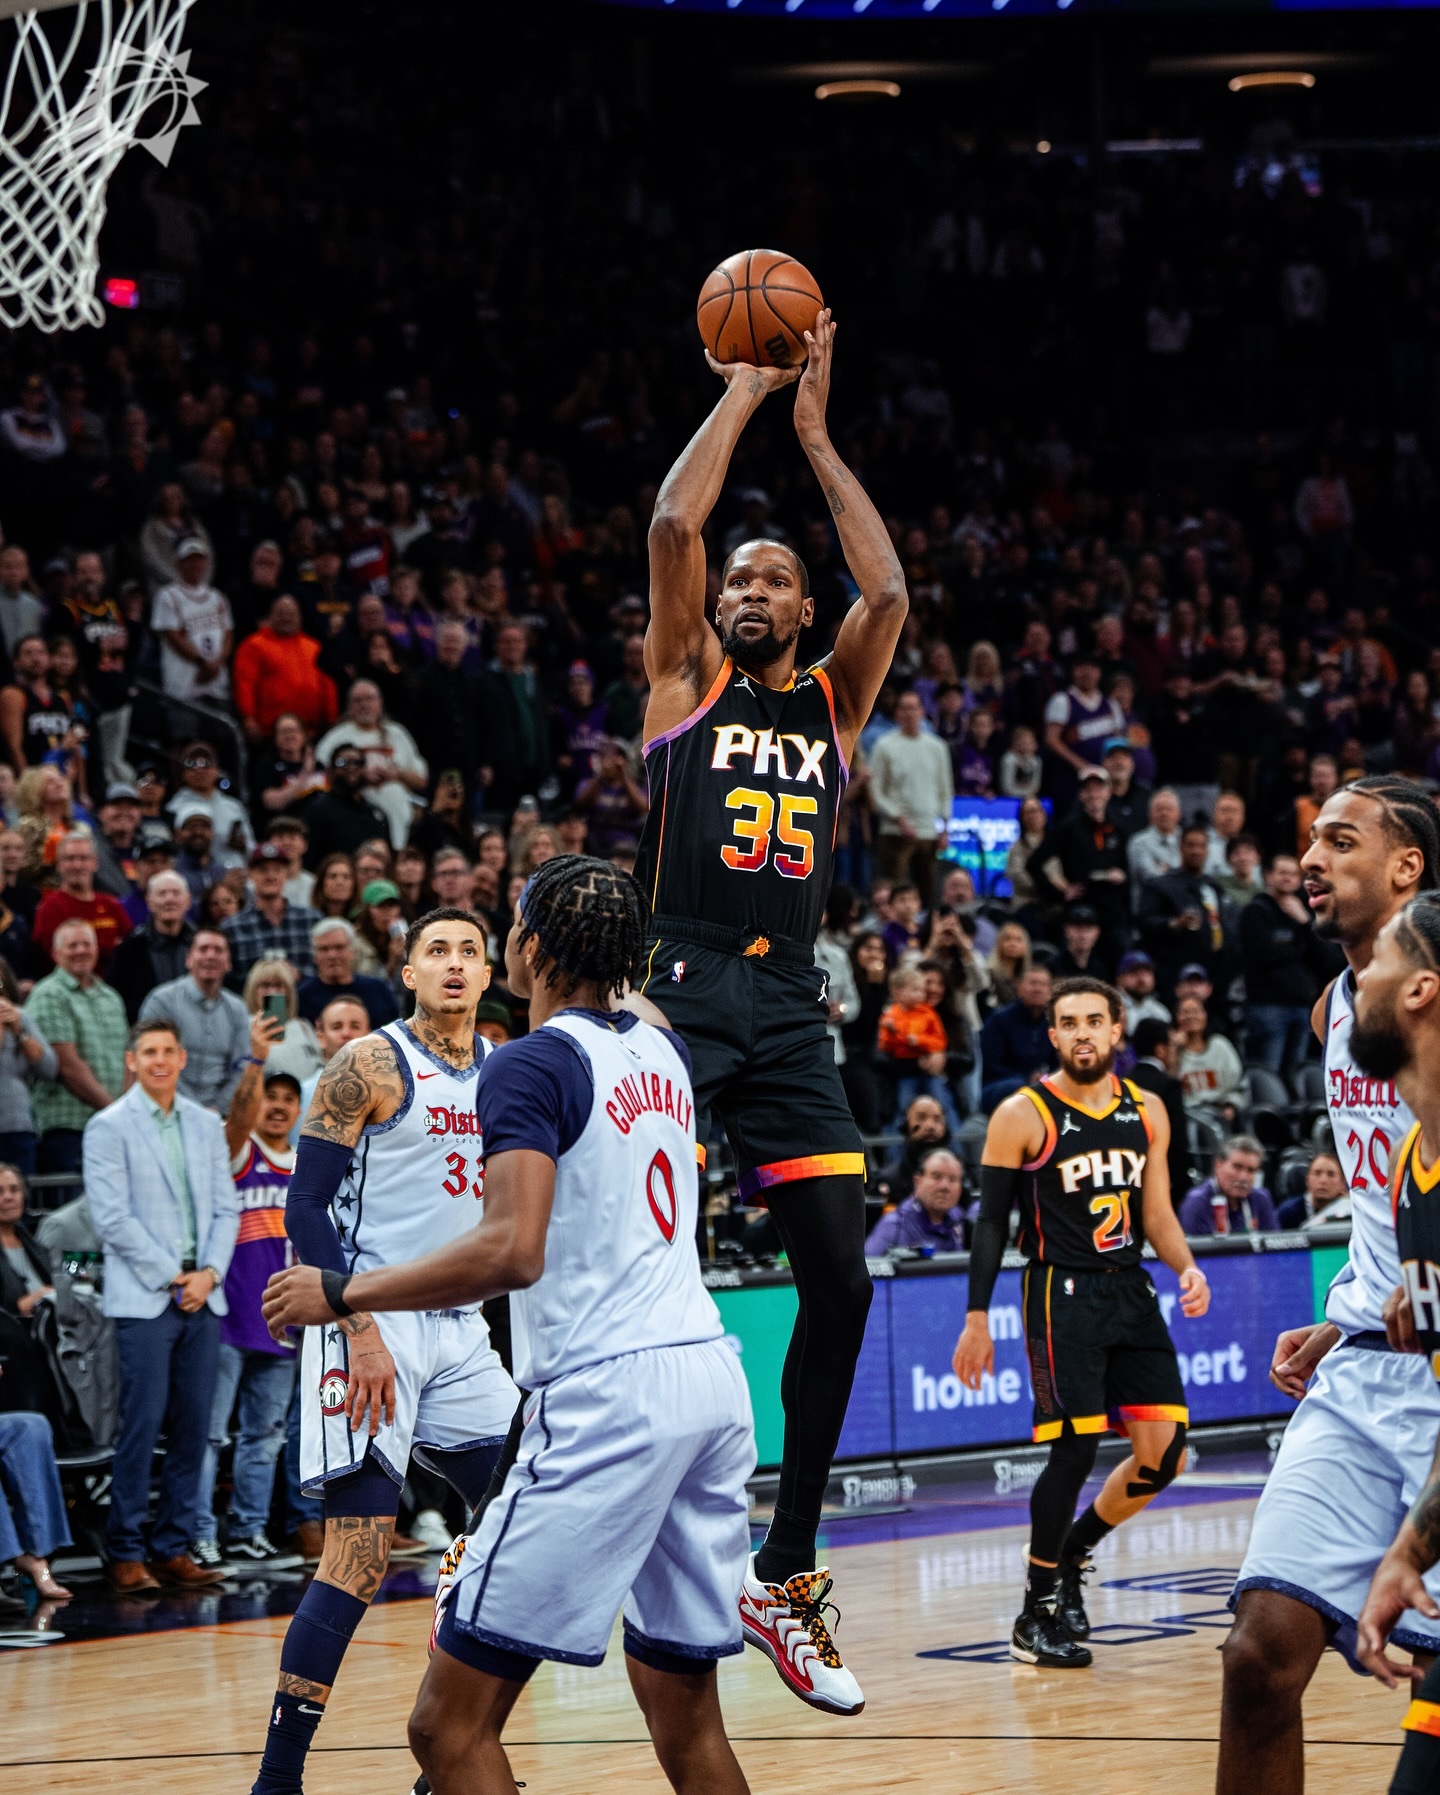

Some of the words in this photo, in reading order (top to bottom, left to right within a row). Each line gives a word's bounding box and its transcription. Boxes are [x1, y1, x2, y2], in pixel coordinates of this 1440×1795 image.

[711, 724, 828, 790] PHX
[721, 787, 818, 880] 35
[606, 1071, 692, 1135] COULIBALY
[1056, 1149, 1147, 1194] PHX
[1346, 1127, 1392, 1192] 20
[646, 1148, 680, 1246] 0
[1090, 1191, 1134, 1252] 21
[912, 1365, 1022, 1412] home
